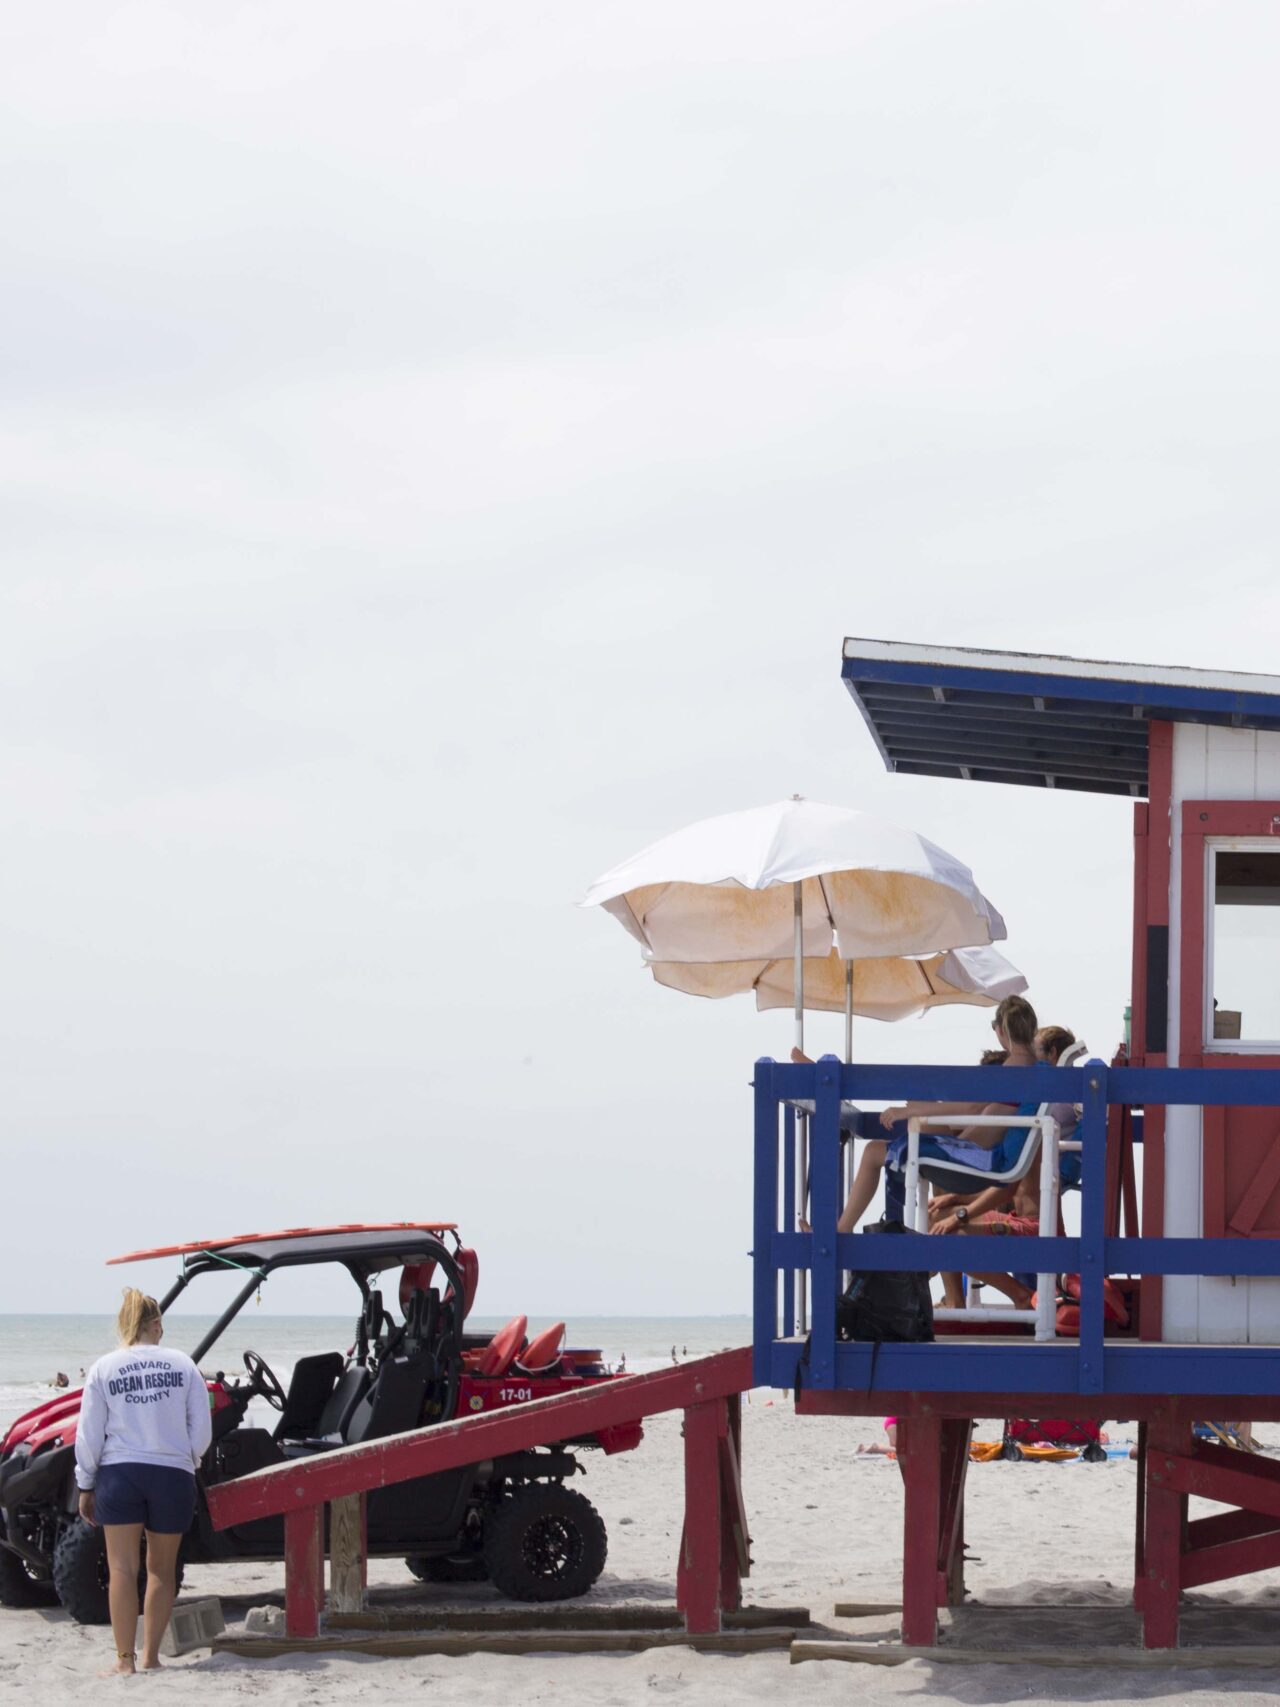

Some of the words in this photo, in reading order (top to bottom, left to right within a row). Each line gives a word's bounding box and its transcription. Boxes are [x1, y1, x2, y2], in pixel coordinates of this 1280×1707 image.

[119, 1361, 171, 1375] BREVARD
[109, 1375, 143, 1396] OCEAN
[145, 1372, 184, 1389] RESCUE
[125, 1389, 170, 1404] COUNTY
[500, 1388, 532, 1401] 17-01
